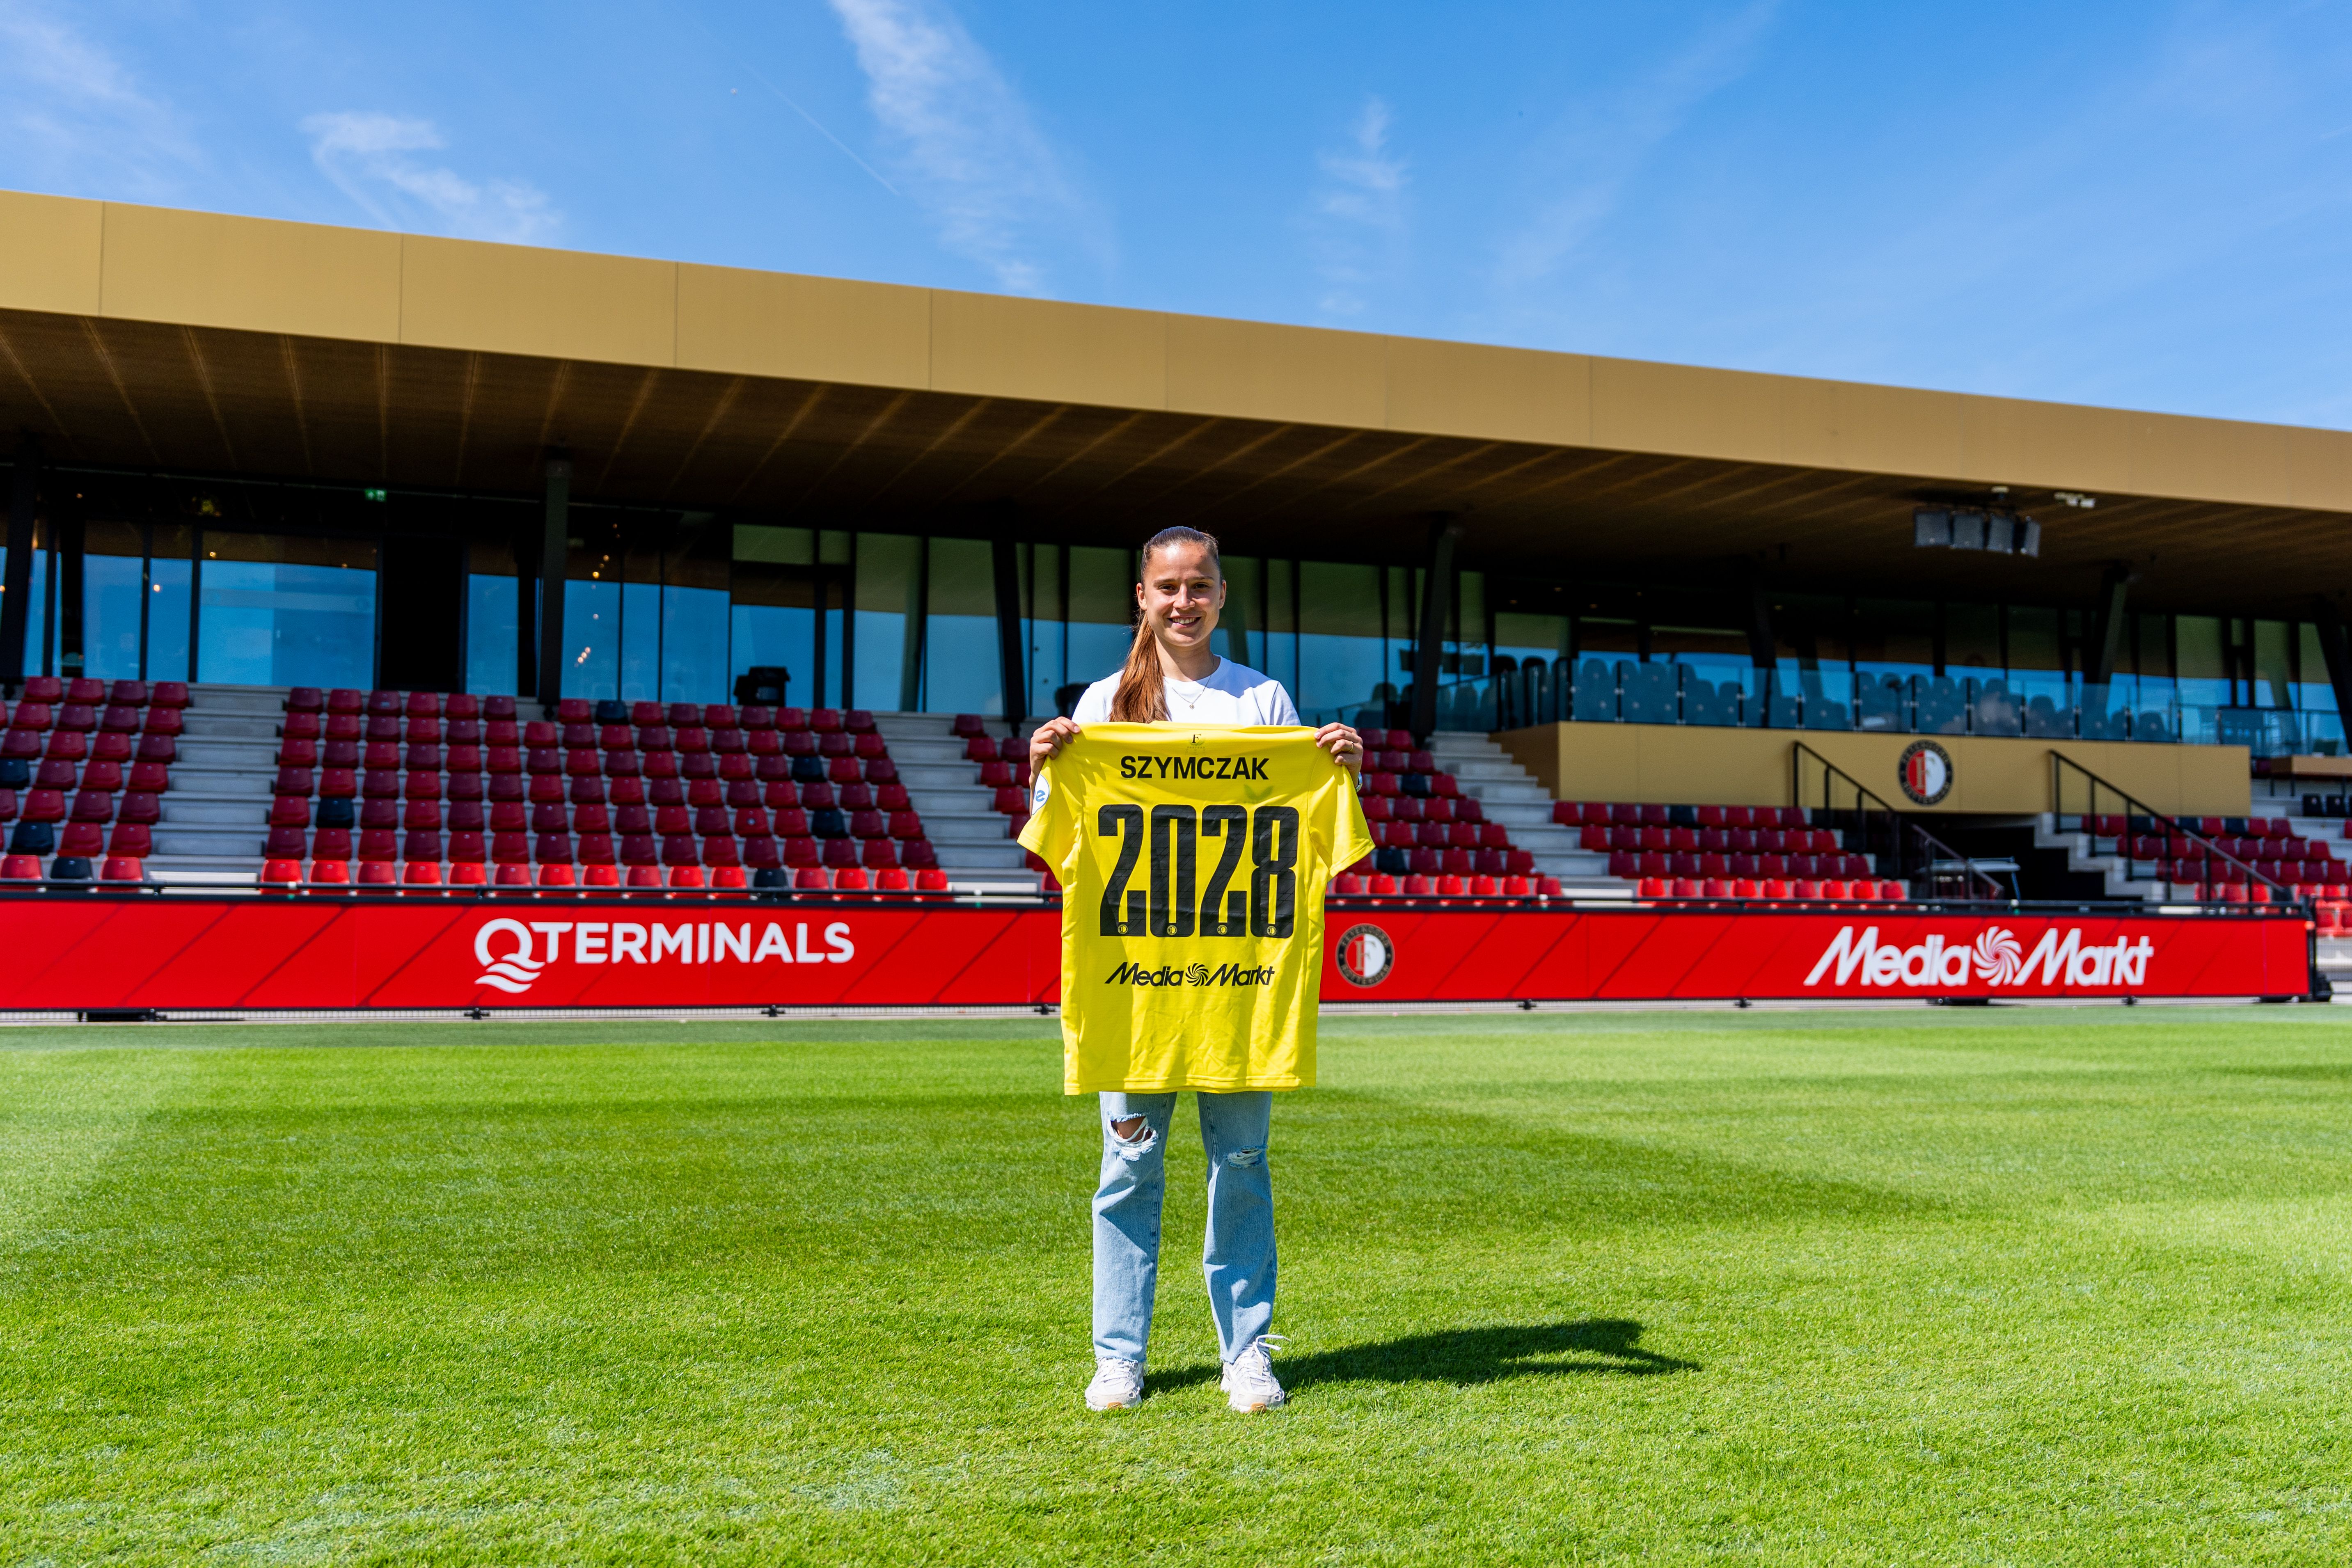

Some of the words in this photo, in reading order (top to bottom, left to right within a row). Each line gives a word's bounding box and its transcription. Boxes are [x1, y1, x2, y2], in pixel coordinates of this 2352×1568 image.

[1120, 755, 1270, 780] SZYMCZAK
[1098, 804, 1299, 939] 2028
[474, 918, 855, 969] QTERMINALS
[1803, 926, 1972, 987] Media
[2012, 927, 2155, 986] Markt
[1104, 961, 1183, 987] Media
[1205, 963, 1275, 987] Markt
